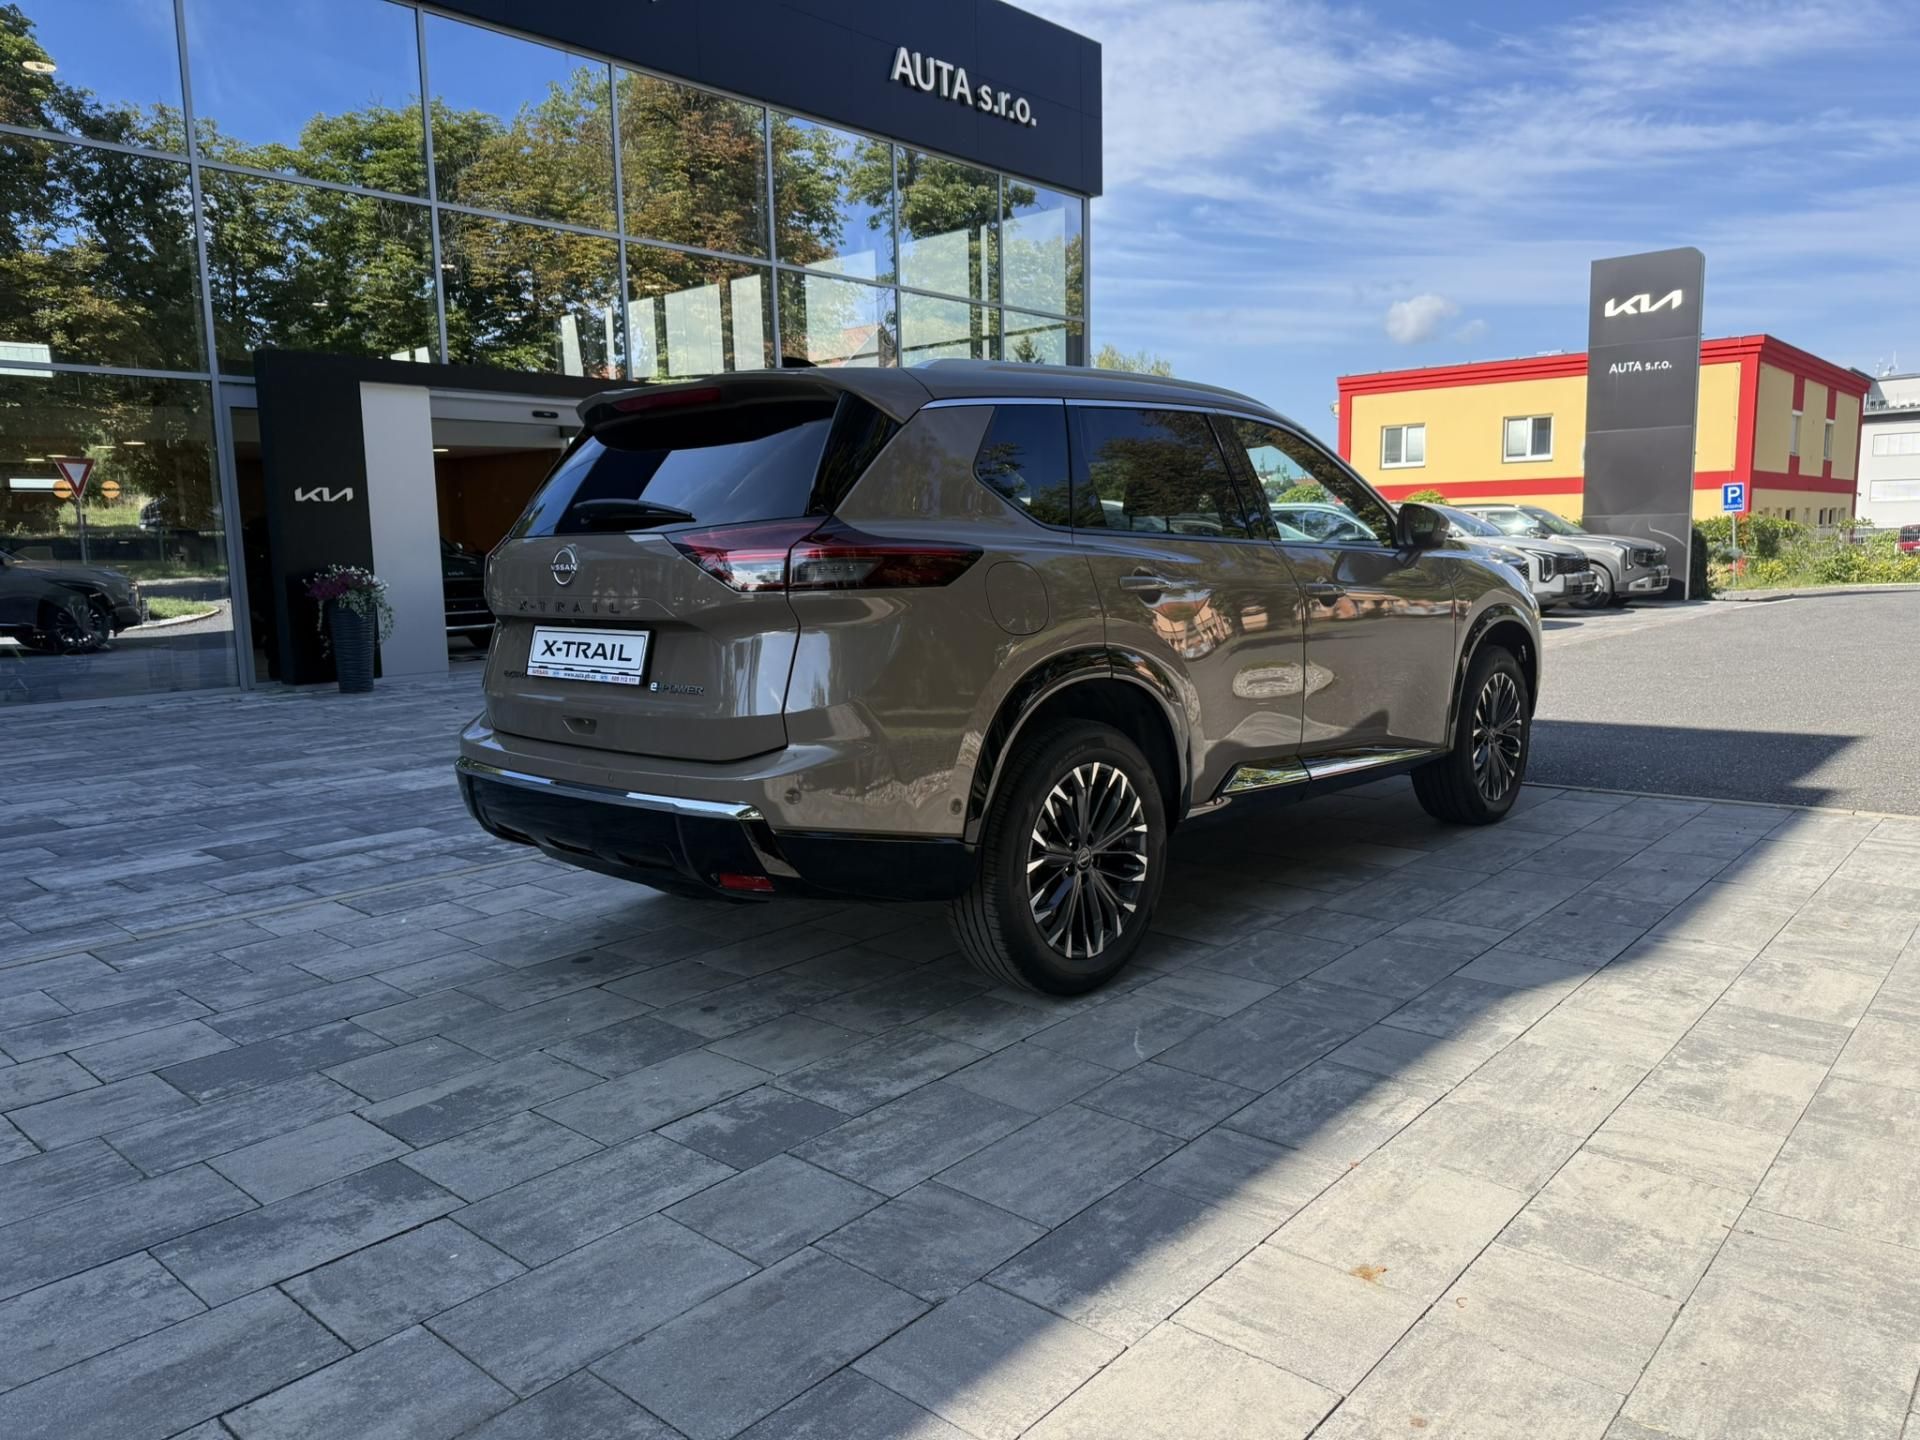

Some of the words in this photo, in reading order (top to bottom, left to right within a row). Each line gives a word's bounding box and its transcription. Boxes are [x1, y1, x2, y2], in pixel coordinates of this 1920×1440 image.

[890, 47, 973, 106] AUTA
[977, 84, 1037, 127] s.r.o.
[1604, 289, 1683, 318] KIA
[1609, 361, 1642, 375] AUTA
[1645, 360, 1673, 371] s.r.o.
[294, 487, 354, 502] KIA
[1727, 486, 1741, 504] P
[519, 600, 621, 614] X-TRAIL
[541, 640, 632, 662] X-TRAIL
